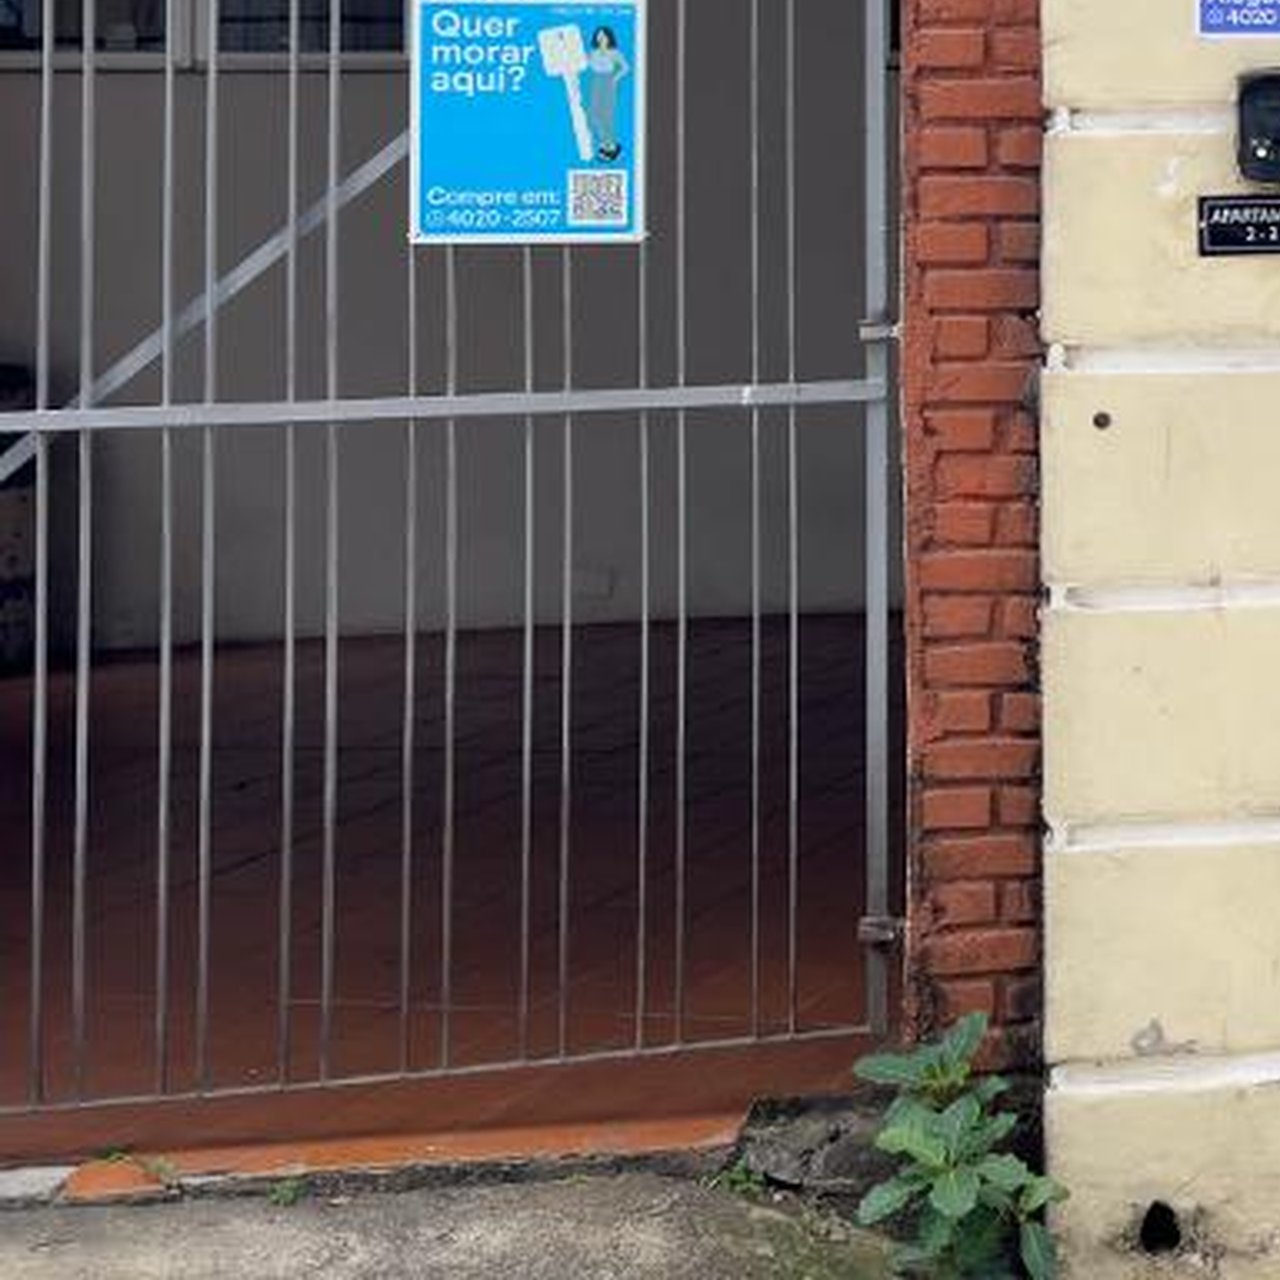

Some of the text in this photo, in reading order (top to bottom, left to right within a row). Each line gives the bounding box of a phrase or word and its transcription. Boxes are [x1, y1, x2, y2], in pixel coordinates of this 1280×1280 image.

[431, 9, 521, 38] Quer
[431, 44, 535, 65] morar
[431, 68, 526, 97] aqui?
[426, 186, 517, 206] Compre
